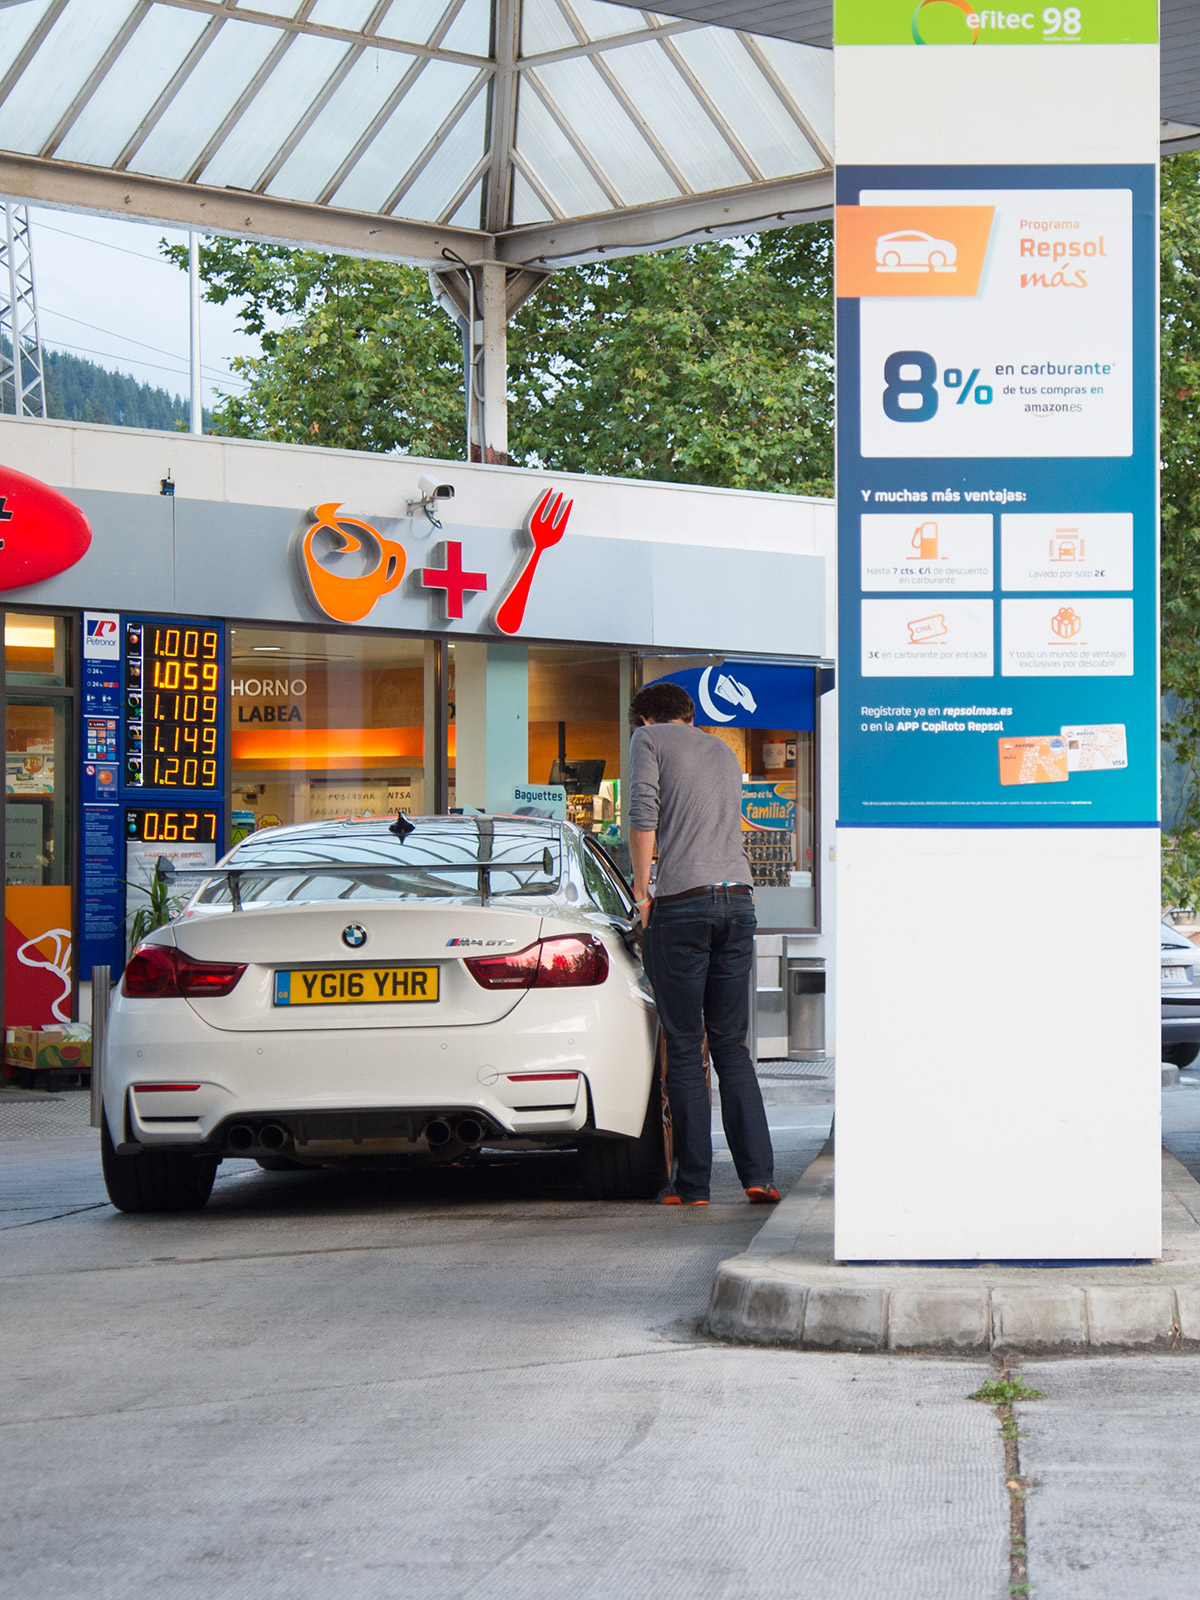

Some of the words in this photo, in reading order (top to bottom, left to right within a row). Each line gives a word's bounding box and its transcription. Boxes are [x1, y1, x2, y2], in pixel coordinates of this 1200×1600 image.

[966, 9, 1035, 29] efitec
[1043, 7, 1081, 35] 98
[1020, 219, 1080, 232] Programa
[1020, 236, 1107, 262] Repsol
[1020, 262, 1088, 288] más
[995, 364, 1015, 375] en
[882, 350, 993, 423] 8%
[1003, 385, 1016, 395] de
[1020, 385, 1037, 395] tus
[1040, 386, 1087, 396] compras
[1090, 386, 1104, 395] en
[1024, 402, 1082, 412] amazon.es
[861, 489, 872, 502] Y
[874, 489, 928, 502] muchas
[931, 488, 961, 502] más
[963, 488, 1027, 505] ventajas:
[866, 567, 891, 575] Hasta
[893, 567, 898, 575] 7
[900, 567, 917, 575] cts.
[933, 567, 944, 575] de
[945, 567, 988, 575] descuento
[899, 576, 910, 584] en
[911, 575, 956, 584] carburante
[1028, 570, 1058, 578] Lavado
[1060, 571, 1073, 579] por
[1075, 570, 1093, 578] solo
[1094, 569, 1106, 578] 2€
[86, 636, 117, 647] Petronor
[154, 629, 217, 659] 1.009
[868, 651, 880, 659] 3€
[893, 651, 939, 659] carburante
[940, 652, 954, 661] por
[955, 651, 988, 659] entrada
[1009, 650, 1015, 658] Y
[1016, 650, 1035, 658] todo
[1049, 650, 1078, 658] mundo
[1079, 650, 1090, 658] de
[1091, 650, 1127, 660] ventajas
[1019, 660, 1061, 668] exclusivas
[1062, 661, 1076, 669] por
[1078, 659, 1116, 668] descubrir
[154, 661, 217, 691] 1.059
[231, 678, 308, 697] HORNO
[154, 694, 217, 722] 1.109
[238, 704, 303, 723] LABEA
[861, 706, 912, 718] Regístrate
[913, 708, 926, 718] ya
[927, 708, 941, 716] en
[943, 705, 1013, 718] repsolmas.es
[861, 723, 868, 732] o
[869, 723, 883, 732] en
[884, 721, 895, 732] la
[896, 721, 919, 732] APP
[921, 720, 965, 734] Copiloto
[967, 720, 1004, 734] Repsol
[154, 726, 217, 755] 1.149
[154, 758, 217, 787] 1.209
[515, 789, 563, 803] Baguettes
[746, 801, 795, 820] familia?
[143, 812, 217, 841] 0.627
[302, 973, 364, 999] YG16
[374, 971, 428, 997] YHR
